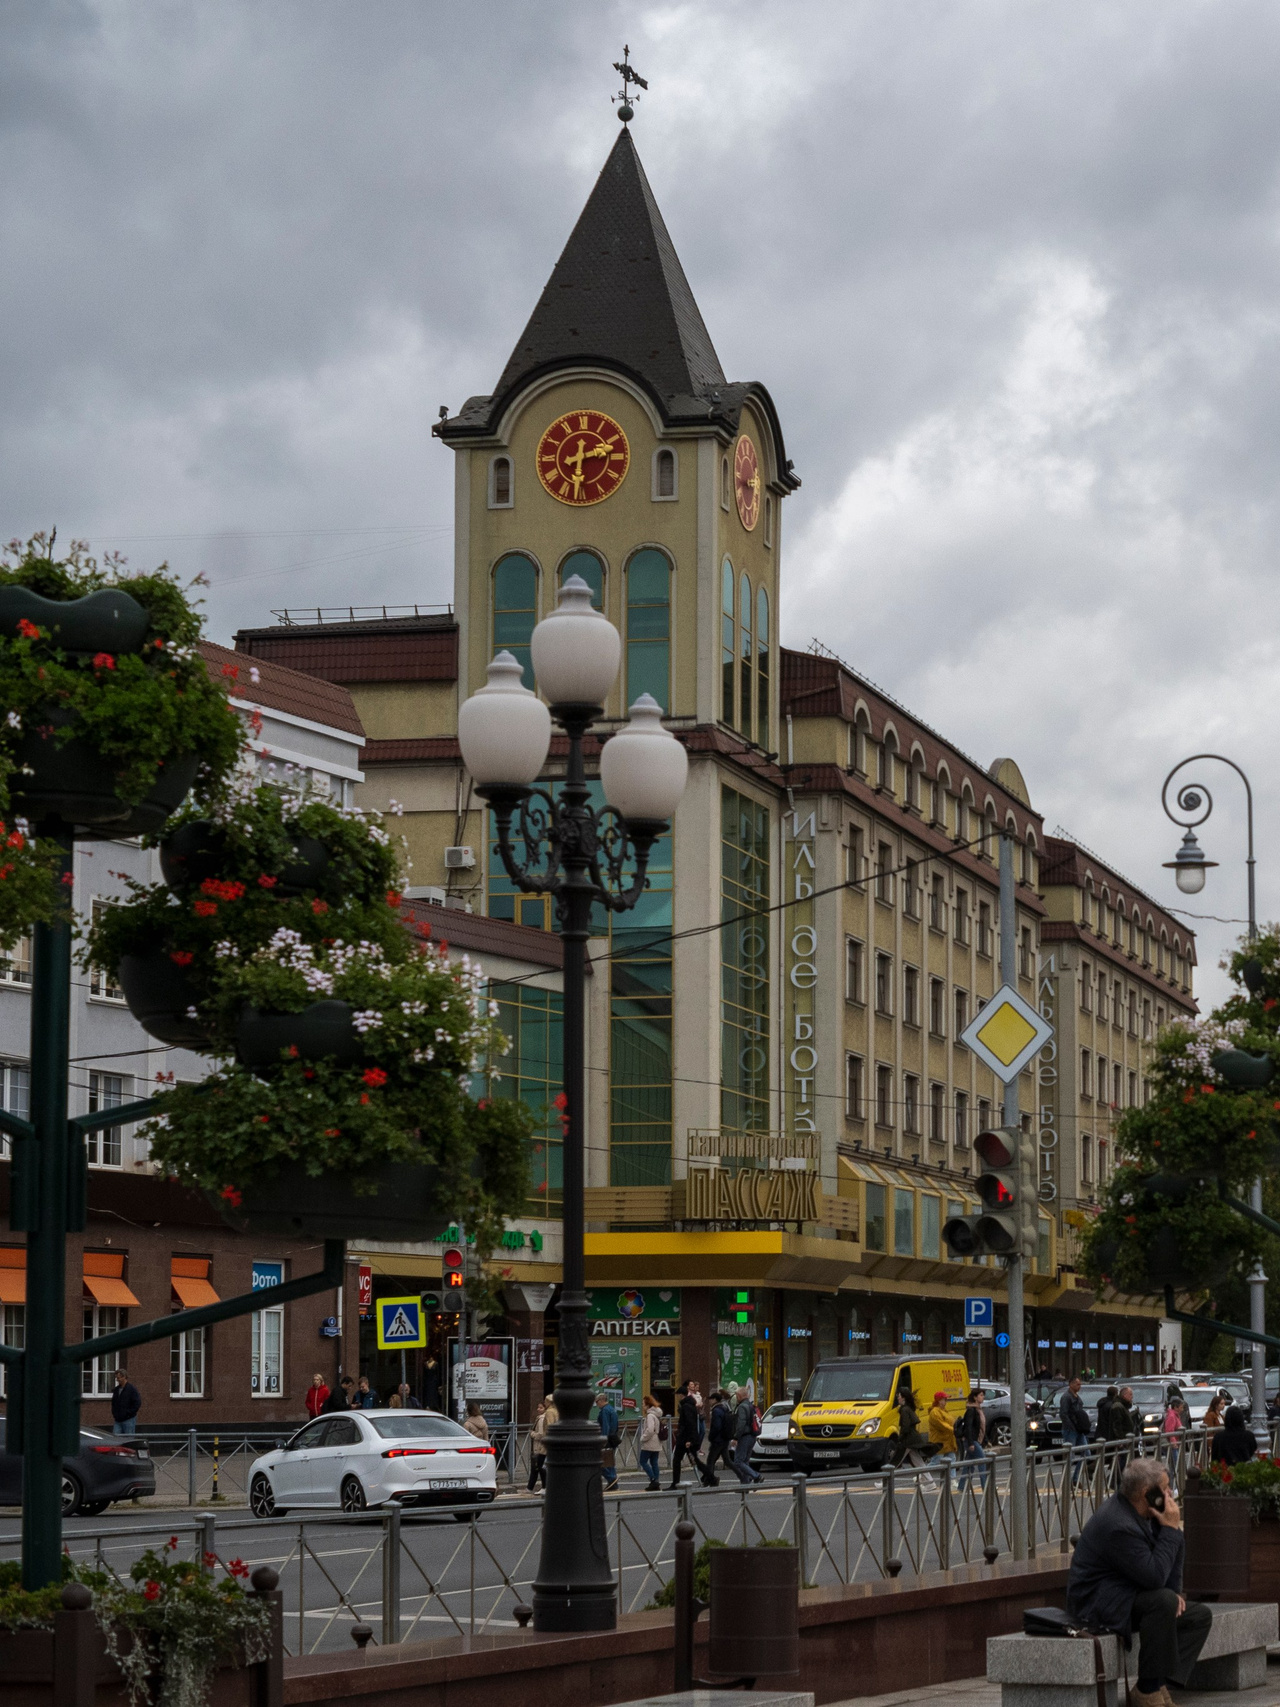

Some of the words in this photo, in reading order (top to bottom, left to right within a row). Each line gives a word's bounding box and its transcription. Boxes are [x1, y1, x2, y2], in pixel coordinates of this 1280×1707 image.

[687, 1167, 819, 1220] ПАССАЖ
[970, 1301, 986, 1323] P
[592, 1321, 671, 1336] АПТЕКА
[802, 1407, 864, 1417] АВАРИЙНАЯ
